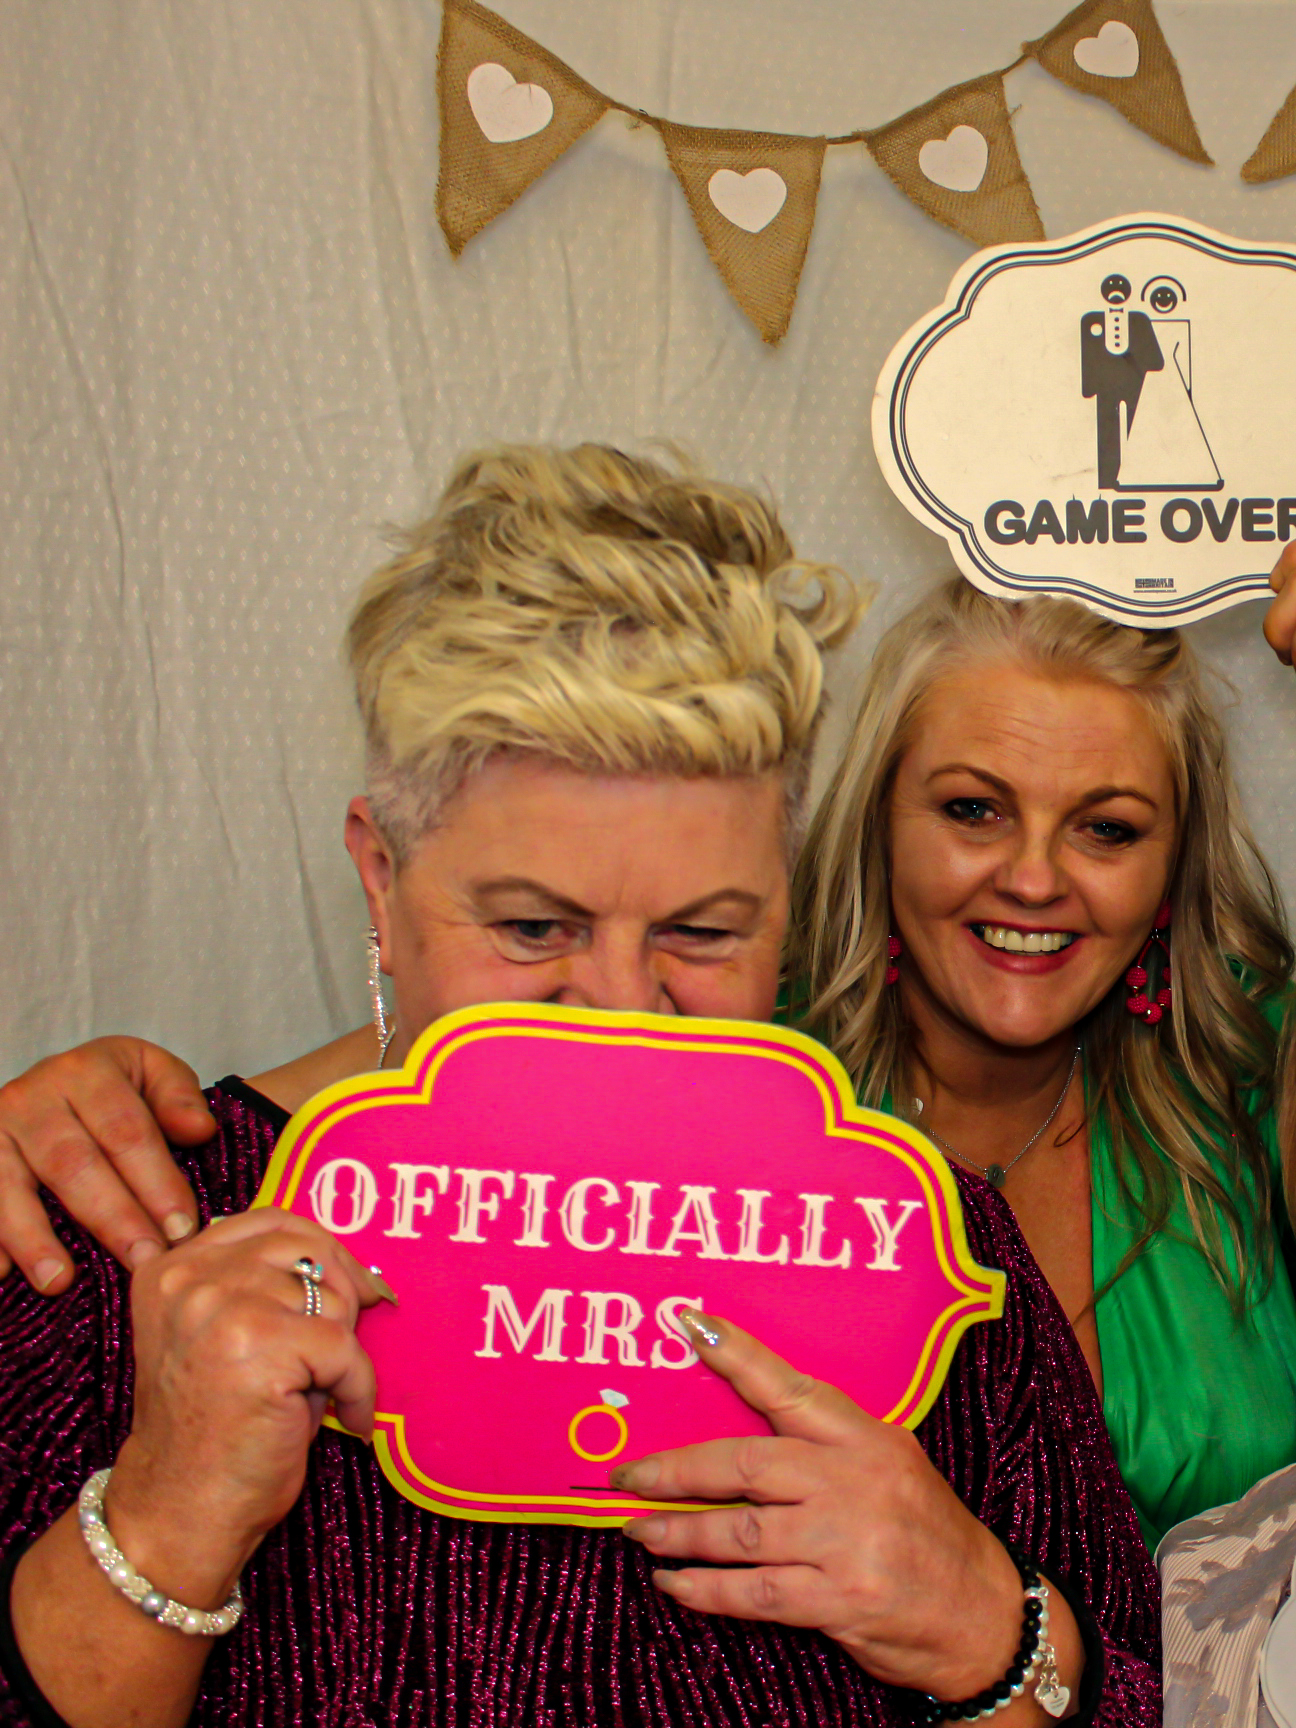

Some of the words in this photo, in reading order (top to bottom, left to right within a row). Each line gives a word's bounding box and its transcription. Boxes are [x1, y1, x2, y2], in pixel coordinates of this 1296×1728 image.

[984, 496, 1148, 546] GAME
[308, 1157, 923, 1272] OFFICIALLY
[474, 1283, 705, 1370] MRS
